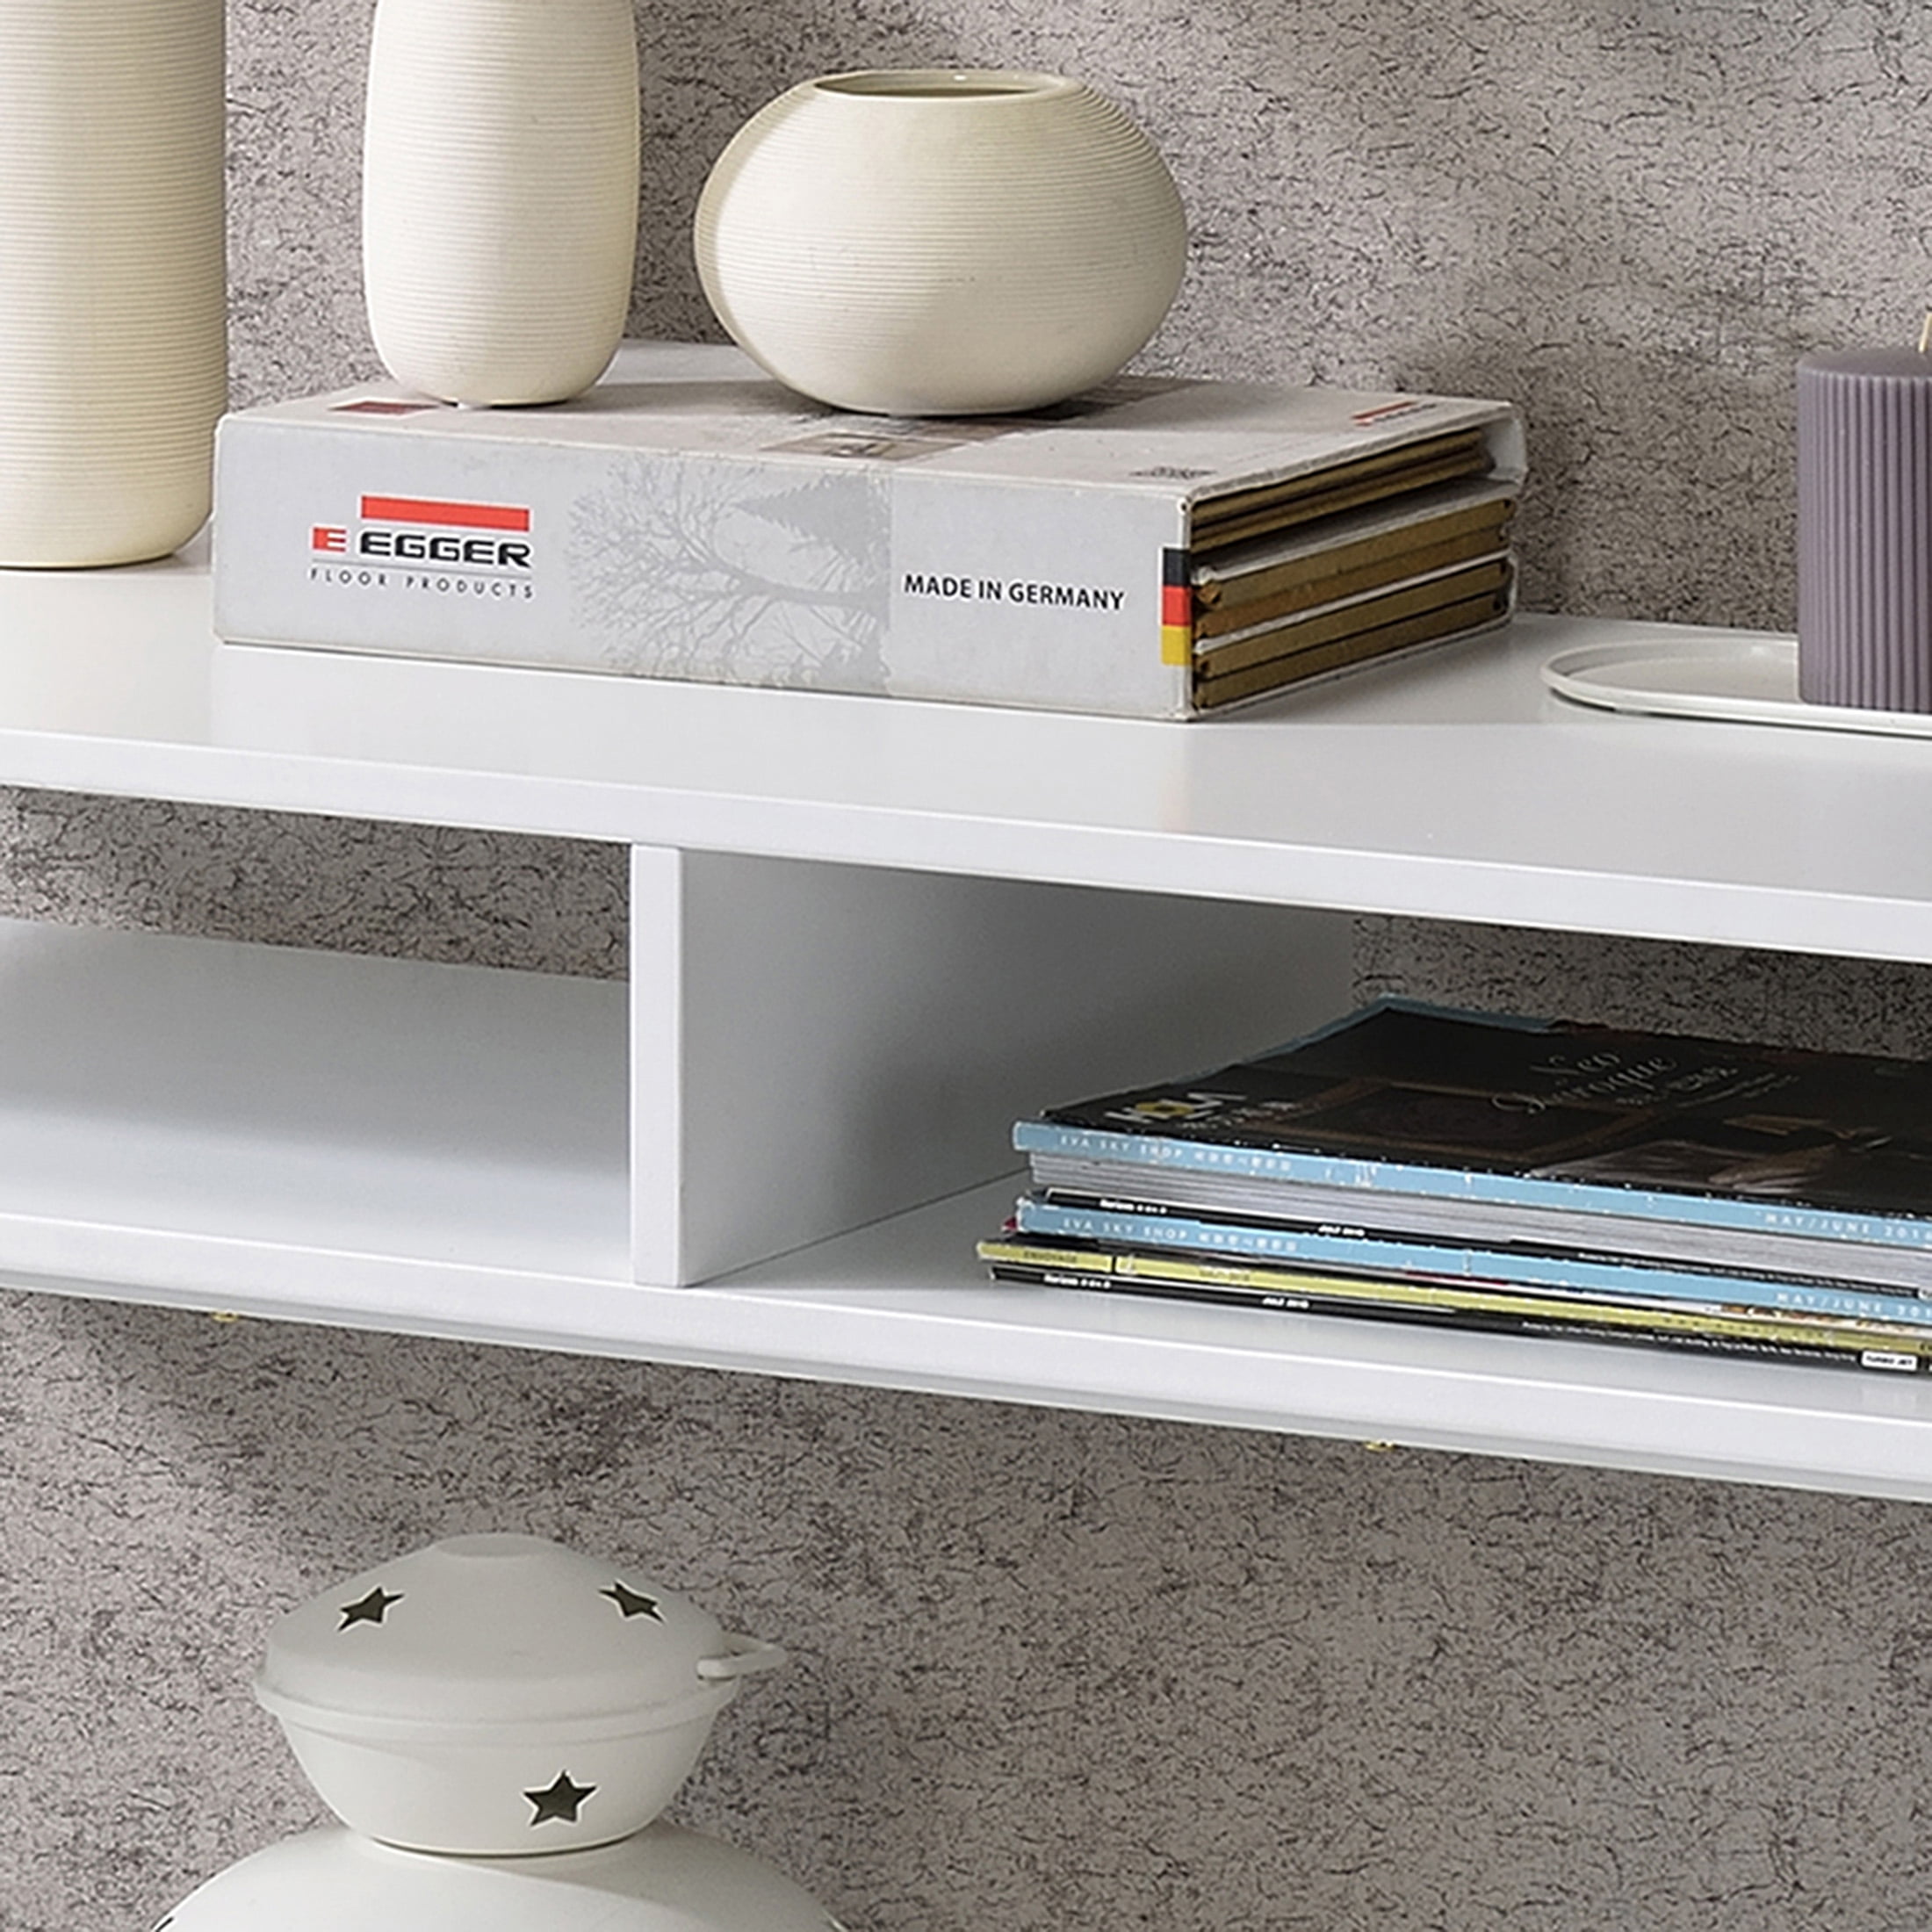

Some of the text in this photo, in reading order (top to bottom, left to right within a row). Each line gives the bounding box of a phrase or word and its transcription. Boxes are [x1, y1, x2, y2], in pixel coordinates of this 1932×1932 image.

[313, 527, 531, 568] E EGGER
[311, 567, 532, 599] FLOOR PRODUCTS
[904, 573, 1125, 610] MADE IN GERMANY
[1061, 1135, 1184, 1159] EVA SKY SHOP
[1063, 1217, 1187, 1242] EVA SKY SHOP
[1765, 1213, 1870, 1234] MAY/JUNE
[1777, 1292, 1883, 1315] MAY/JUNE
